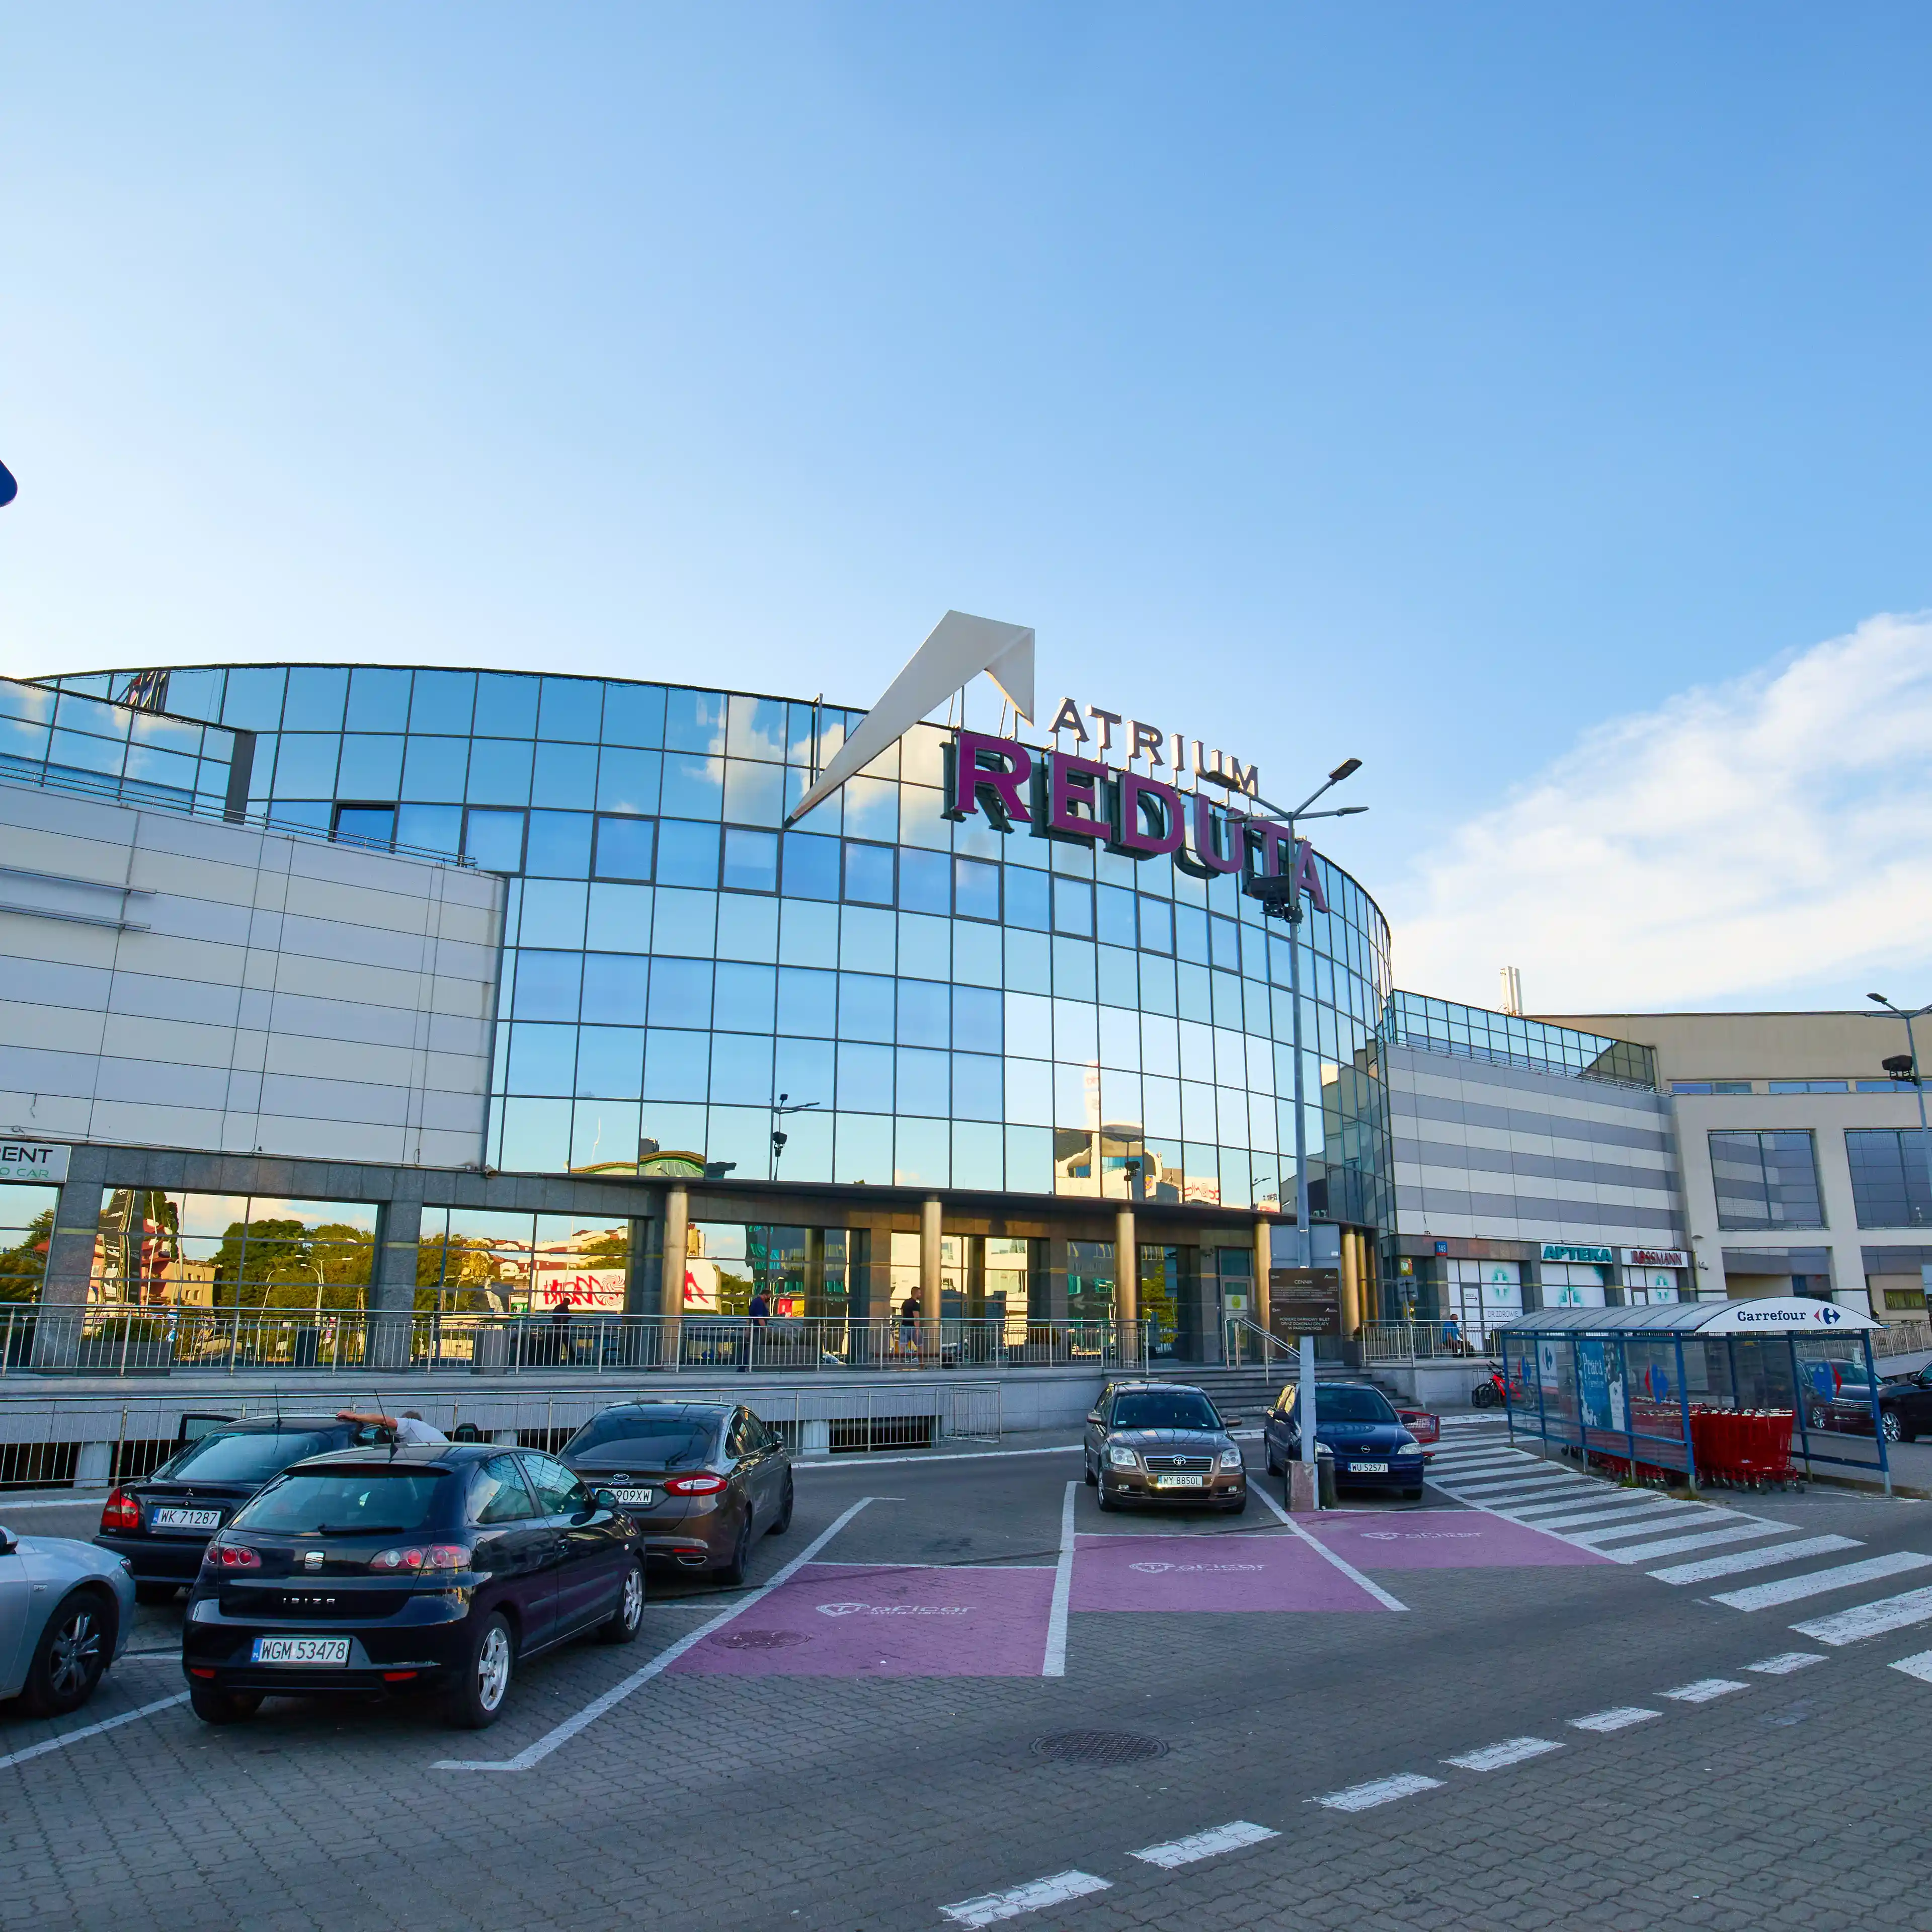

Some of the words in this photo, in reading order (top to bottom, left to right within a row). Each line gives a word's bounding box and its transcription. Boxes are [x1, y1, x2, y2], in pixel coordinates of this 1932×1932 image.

[1047, 697, 1258, 797] ATRIUM
[953, 731, 1329, 914] REDUTA
[0, 1146, 53, 1163] ENT
[17, 1168, 49, 1177] CAR
[1543, 1245, 1612, 1262] APTEKA
[1631, 1250, 1682, 1265] ROSSMANN
[1737, 1310, 1806, 1322] Carrefour
[1163, 1477, 1173, 1485] WY
[1176, 1477, 1200, 1485] 8850L
[616, 1490, 650, 1501] 909XW
[160, 1510, 177, 1523] WK
[180, 1511, 218, 1524] 71287
[261, 1641, 293, 1659] WGM
[296, 1641, 346, 1660] 53478
